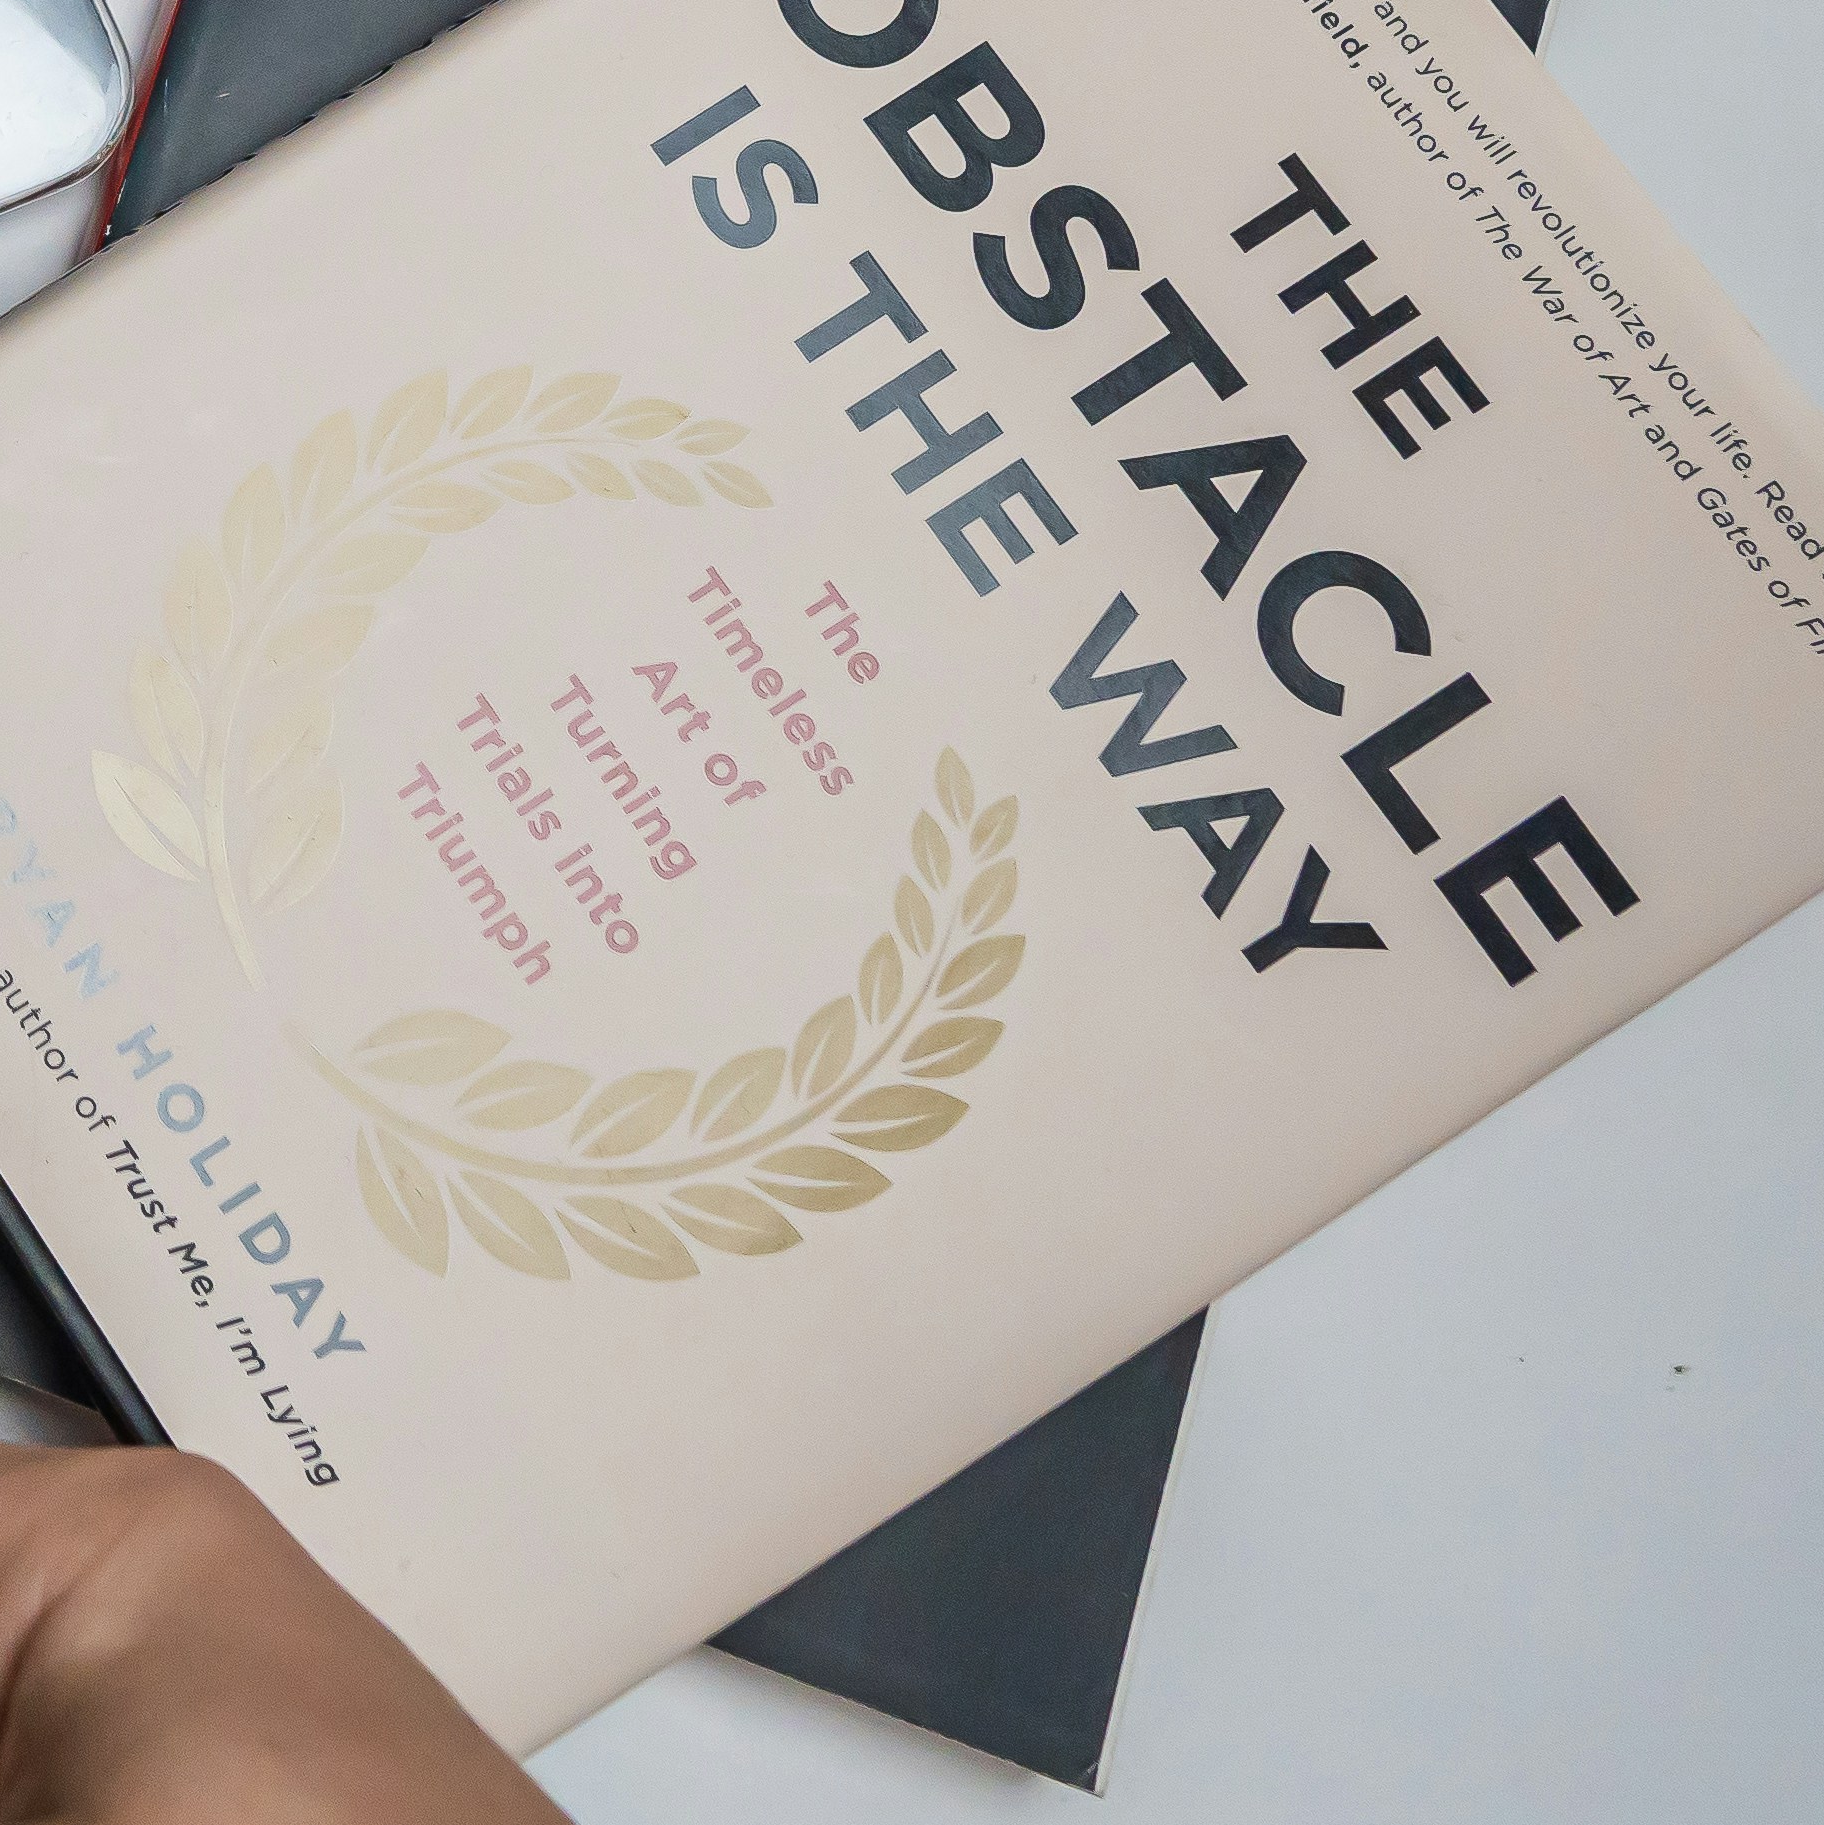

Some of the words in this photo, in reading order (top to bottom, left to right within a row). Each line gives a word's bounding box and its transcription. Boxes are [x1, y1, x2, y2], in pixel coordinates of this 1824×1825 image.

[1230, 153, 1489, 459] THE
[1367, 72, 1449, 161] author
[1447, 172, 1484, 200] of
[1476, 206, 1522, 260] The
[1522, 265, 1578, 323] War
[1573, 335, 1614, 360] of
[1598, 374, 1651, 418] Art
[1645, 425, 1703, 481] and
[1697, 488, 1770, 571] Gates
[1768, 580, 1811, 607] of
[1374, 1, 1429, 54] and
[1415, 57, 1469, 112] you
[1468, 115, 1517, 164] will
[1507, 170, 1655, 349] revolutionize
[1649, 353, 1715, 417] your
[1710, 422, 1752, 478] life.
[1755, 480, 1824, 560] Read
[650, 86, 819, 249] IS
[794, 252, 1078, 598] THE
[1048, 592, 1388, 973] WAY
[803, 580, 880, 684] The
[550, 673, 697, 880] Turning
[632, 661, 710, 743] Art
[704, 752, 767, 807] of
[687, 566, 854, 796] Timeless
[397, 761, 552, 985] Triumph
[457, 693, 562, 840] Trials
[555, 843, 638, 954] into
[76, 1097, 116, 1131] of
[106, 1140, 177, 1233] Trust
[168, 1242, 213, 1307] Me,
[261, 1385, 339, 1486] Lying
[117, 1025, 367, 1360] HOLIDAY
